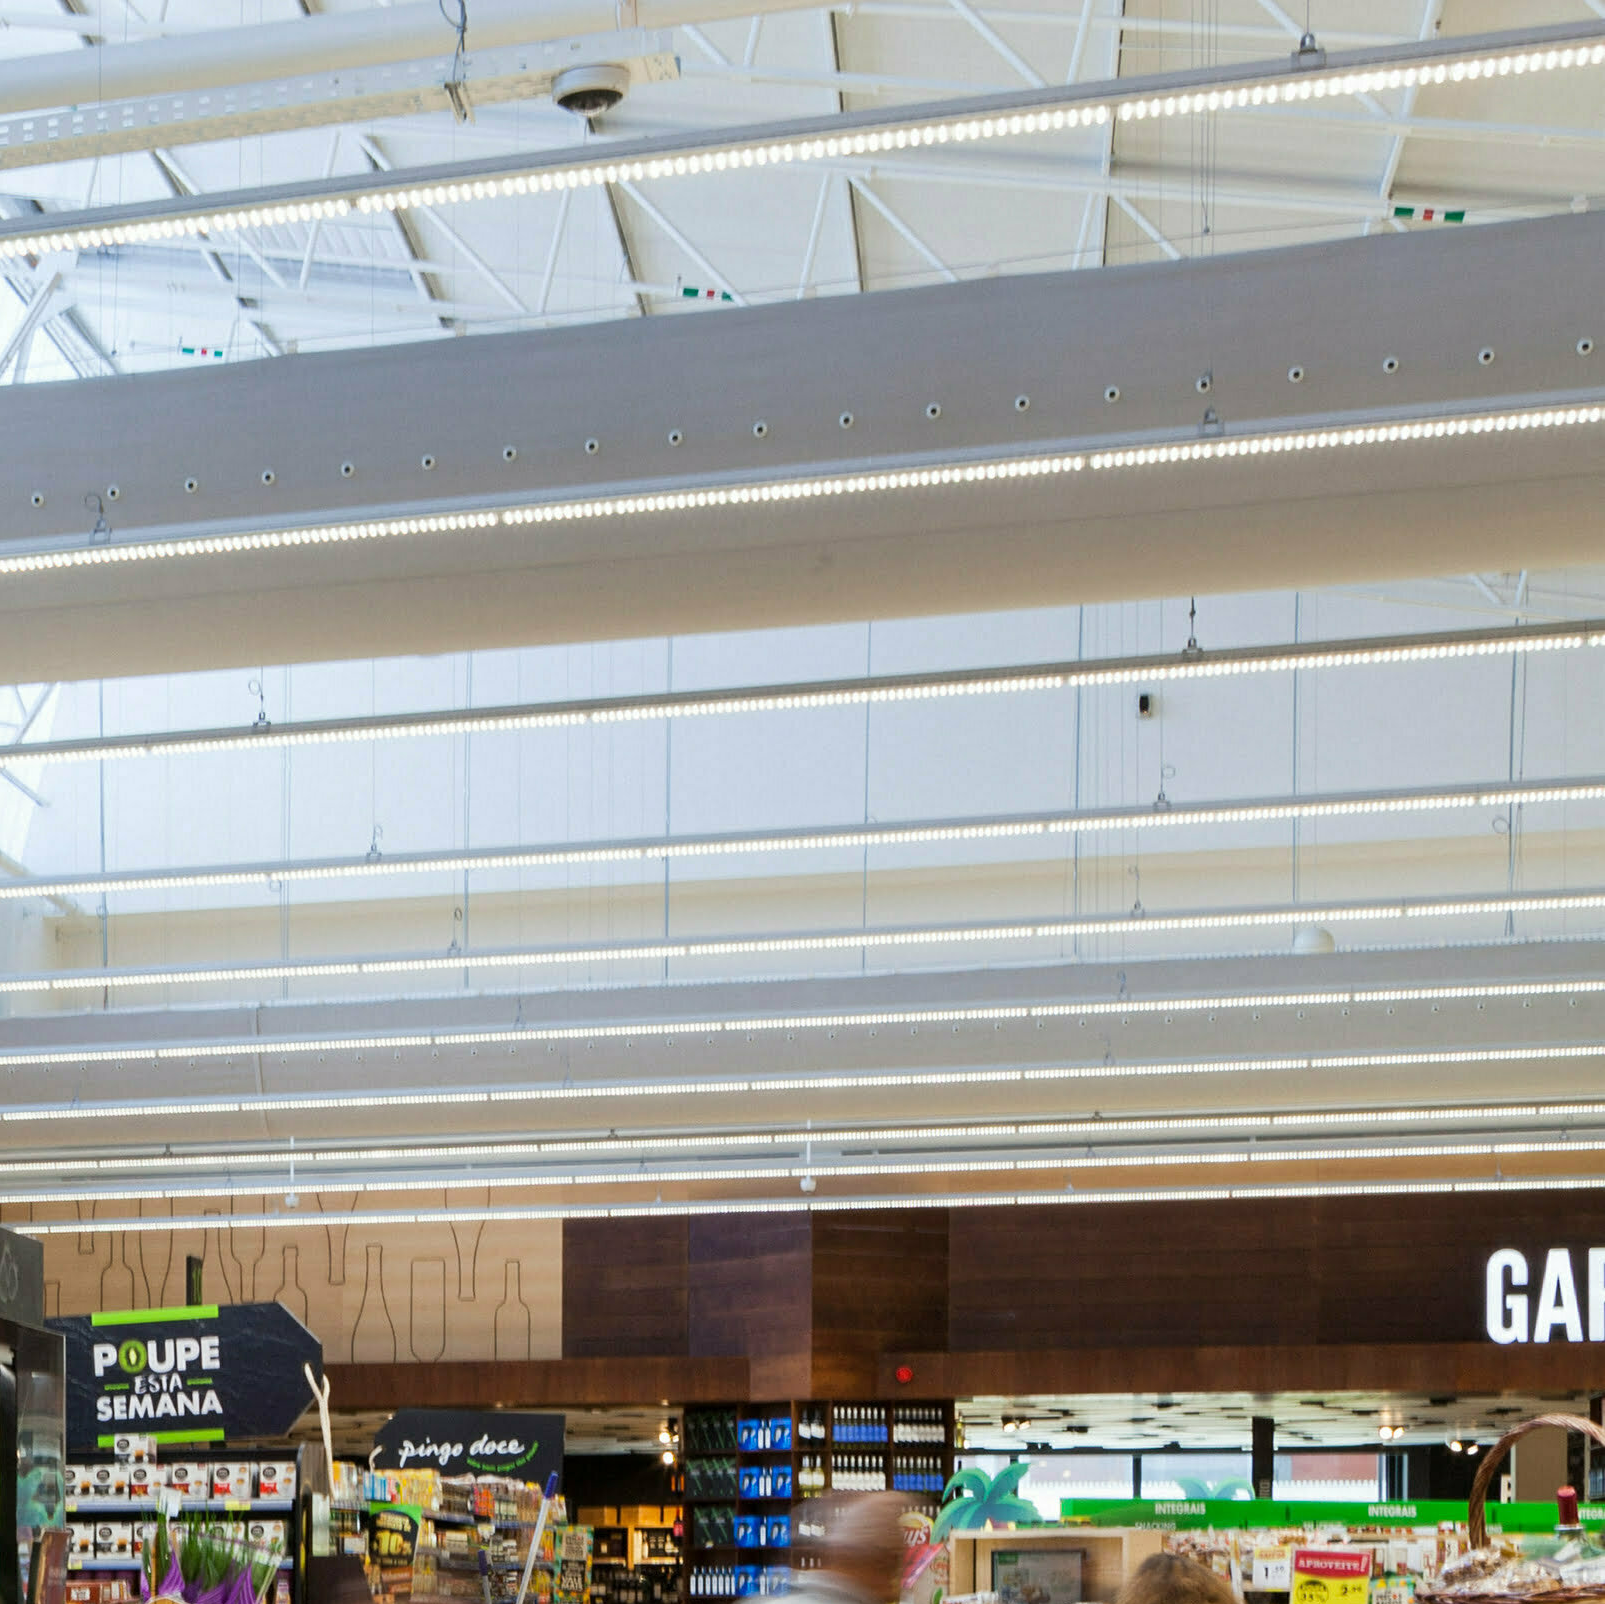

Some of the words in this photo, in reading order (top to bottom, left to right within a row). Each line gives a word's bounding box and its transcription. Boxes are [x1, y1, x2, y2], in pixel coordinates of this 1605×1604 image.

[93, 1336, 220, 1377] POUPE
[134, 1372, 183, 1394] ESTA
[96, 1389, 223, 1422] SEMANA
[398, 1436, 463, 1468] pingo
[469, 1433, 525, 1456] doce
[1155, 1502, 1206, 1515] INTEGRAIS
[1368, 1504, 1417, 1518] INTEGRAIS
[1298, 1555, 1369, 1572] APROVEITE!
